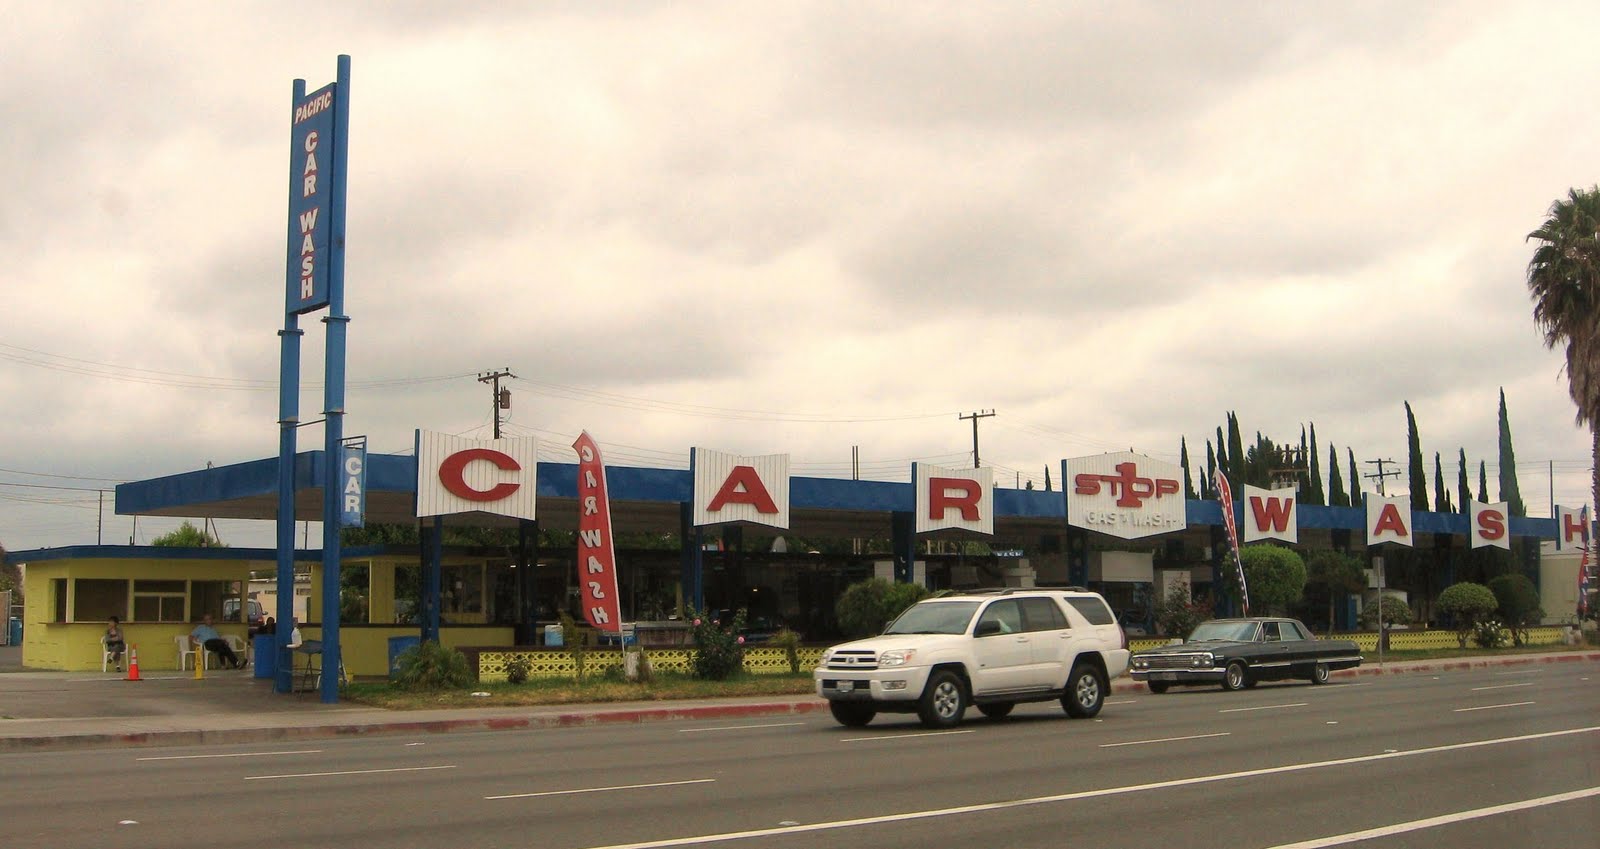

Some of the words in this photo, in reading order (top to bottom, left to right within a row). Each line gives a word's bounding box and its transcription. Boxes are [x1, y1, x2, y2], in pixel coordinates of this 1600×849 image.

[294, 91, 332, 124] PACIFIC
[304, 131, 318, 197] CAR
[300, 208, 319, 300] WASH
[344, 457, 362, 512] CAR
[1086, 511, 1117, 526] GAS
